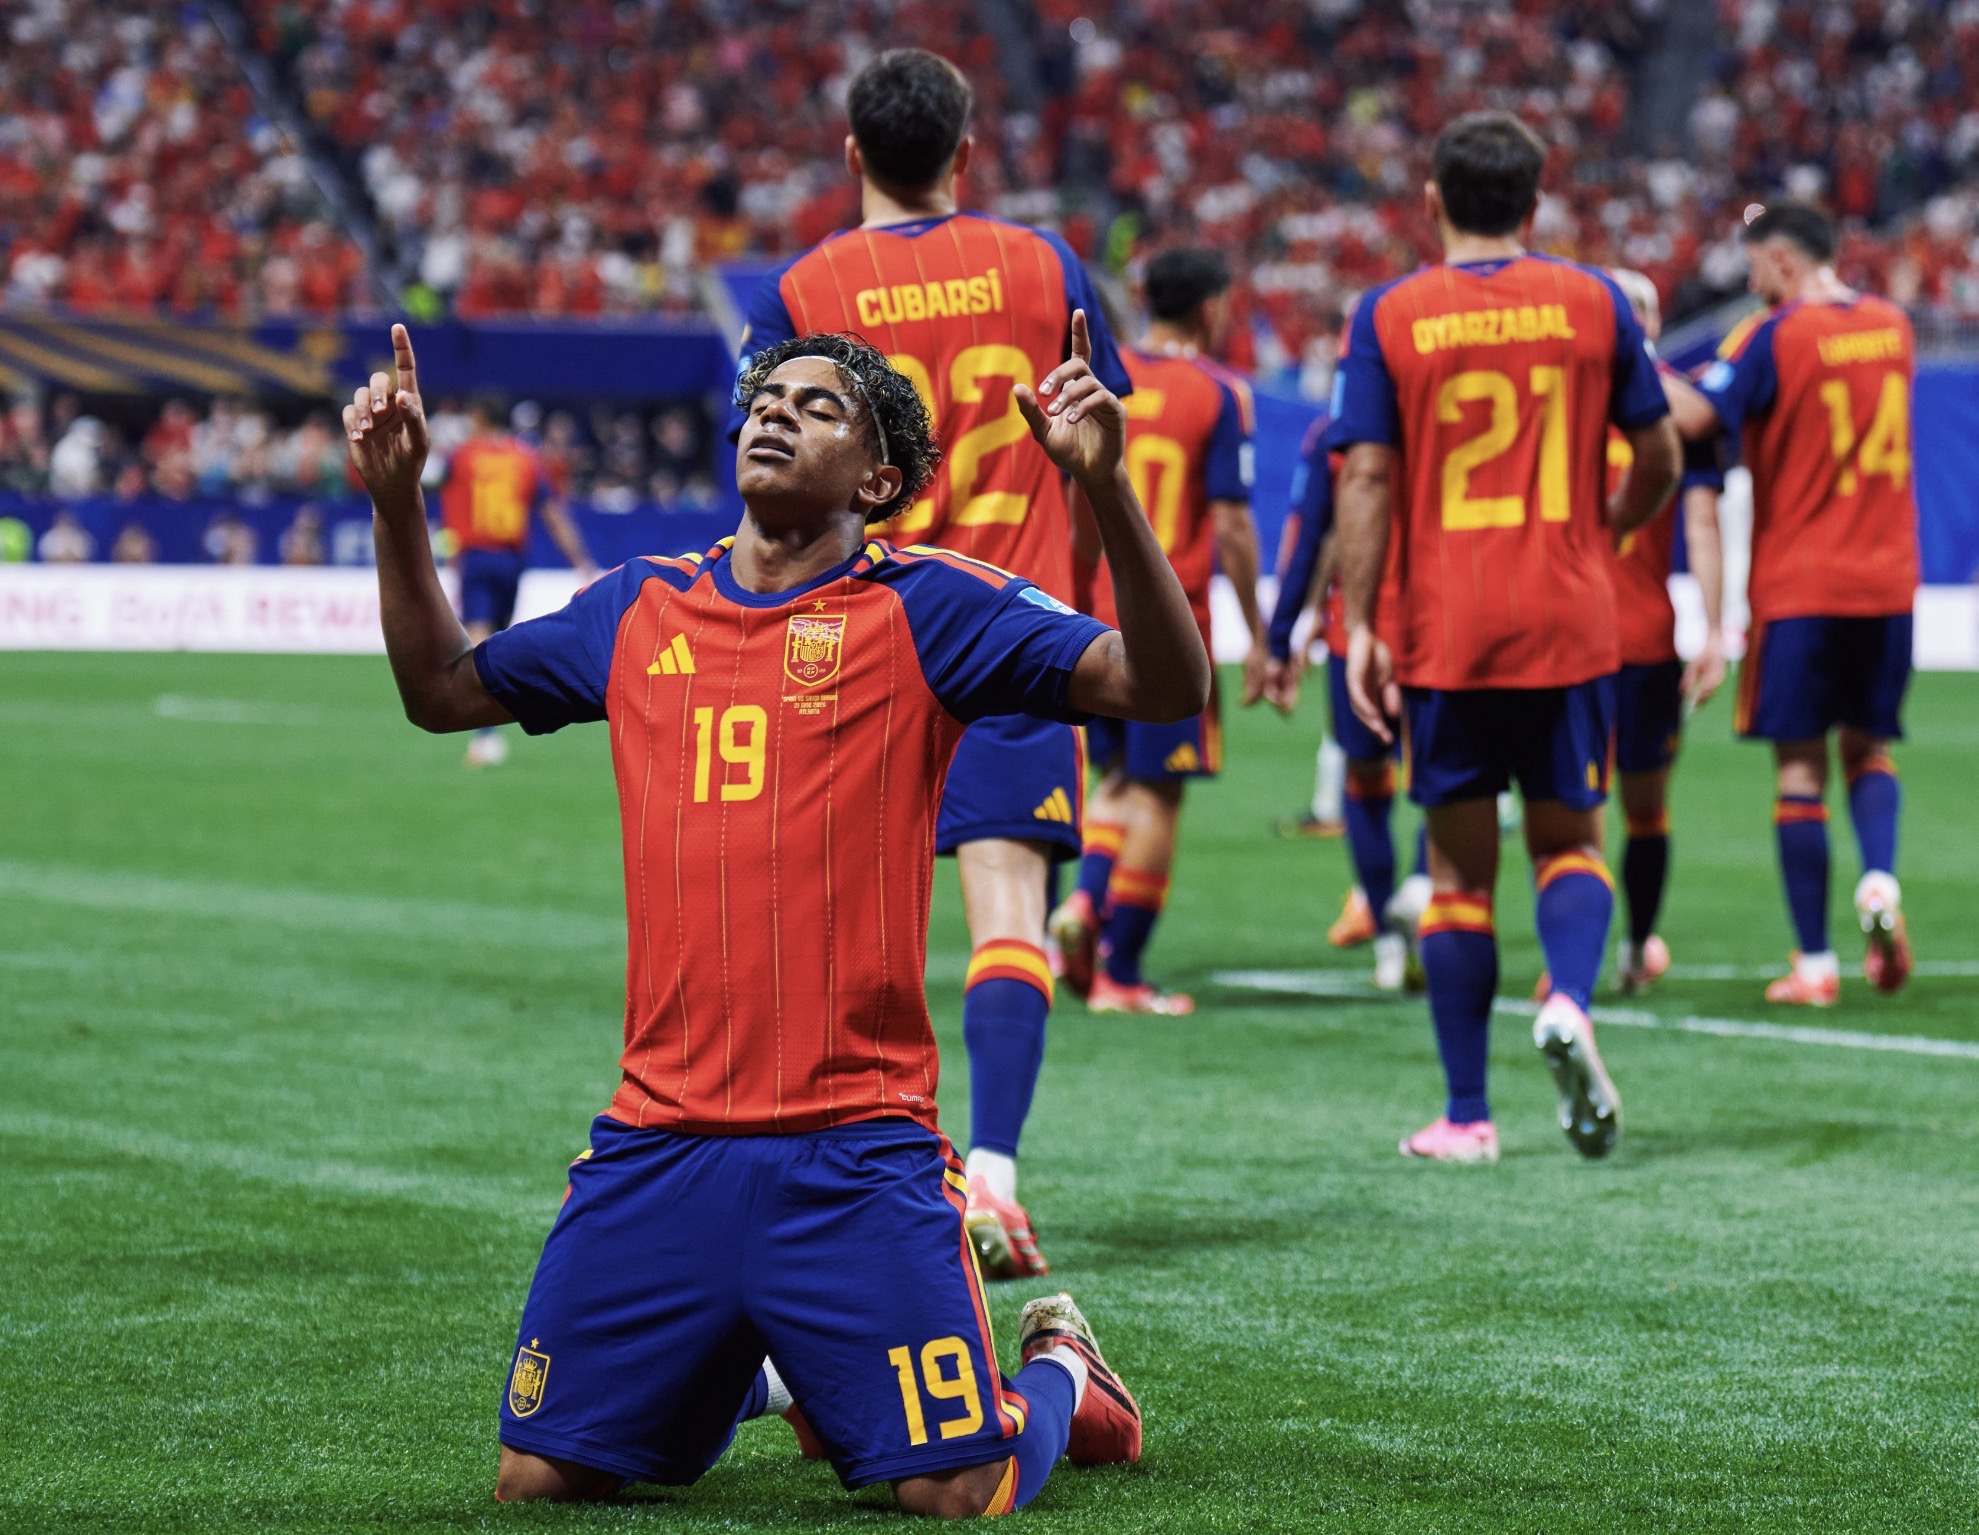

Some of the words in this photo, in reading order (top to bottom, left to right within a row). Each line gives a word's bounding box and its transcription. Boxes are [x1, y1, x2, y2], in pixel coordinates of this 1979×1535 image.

[856, 268, 1003, 328] CUBARSÍ
[1438, 364, 1571, 531] 21
[1820, 371, 1909, 496] 14
[693, 704, 768, 803] 19
[887, 1336, 984, 1446] 19
